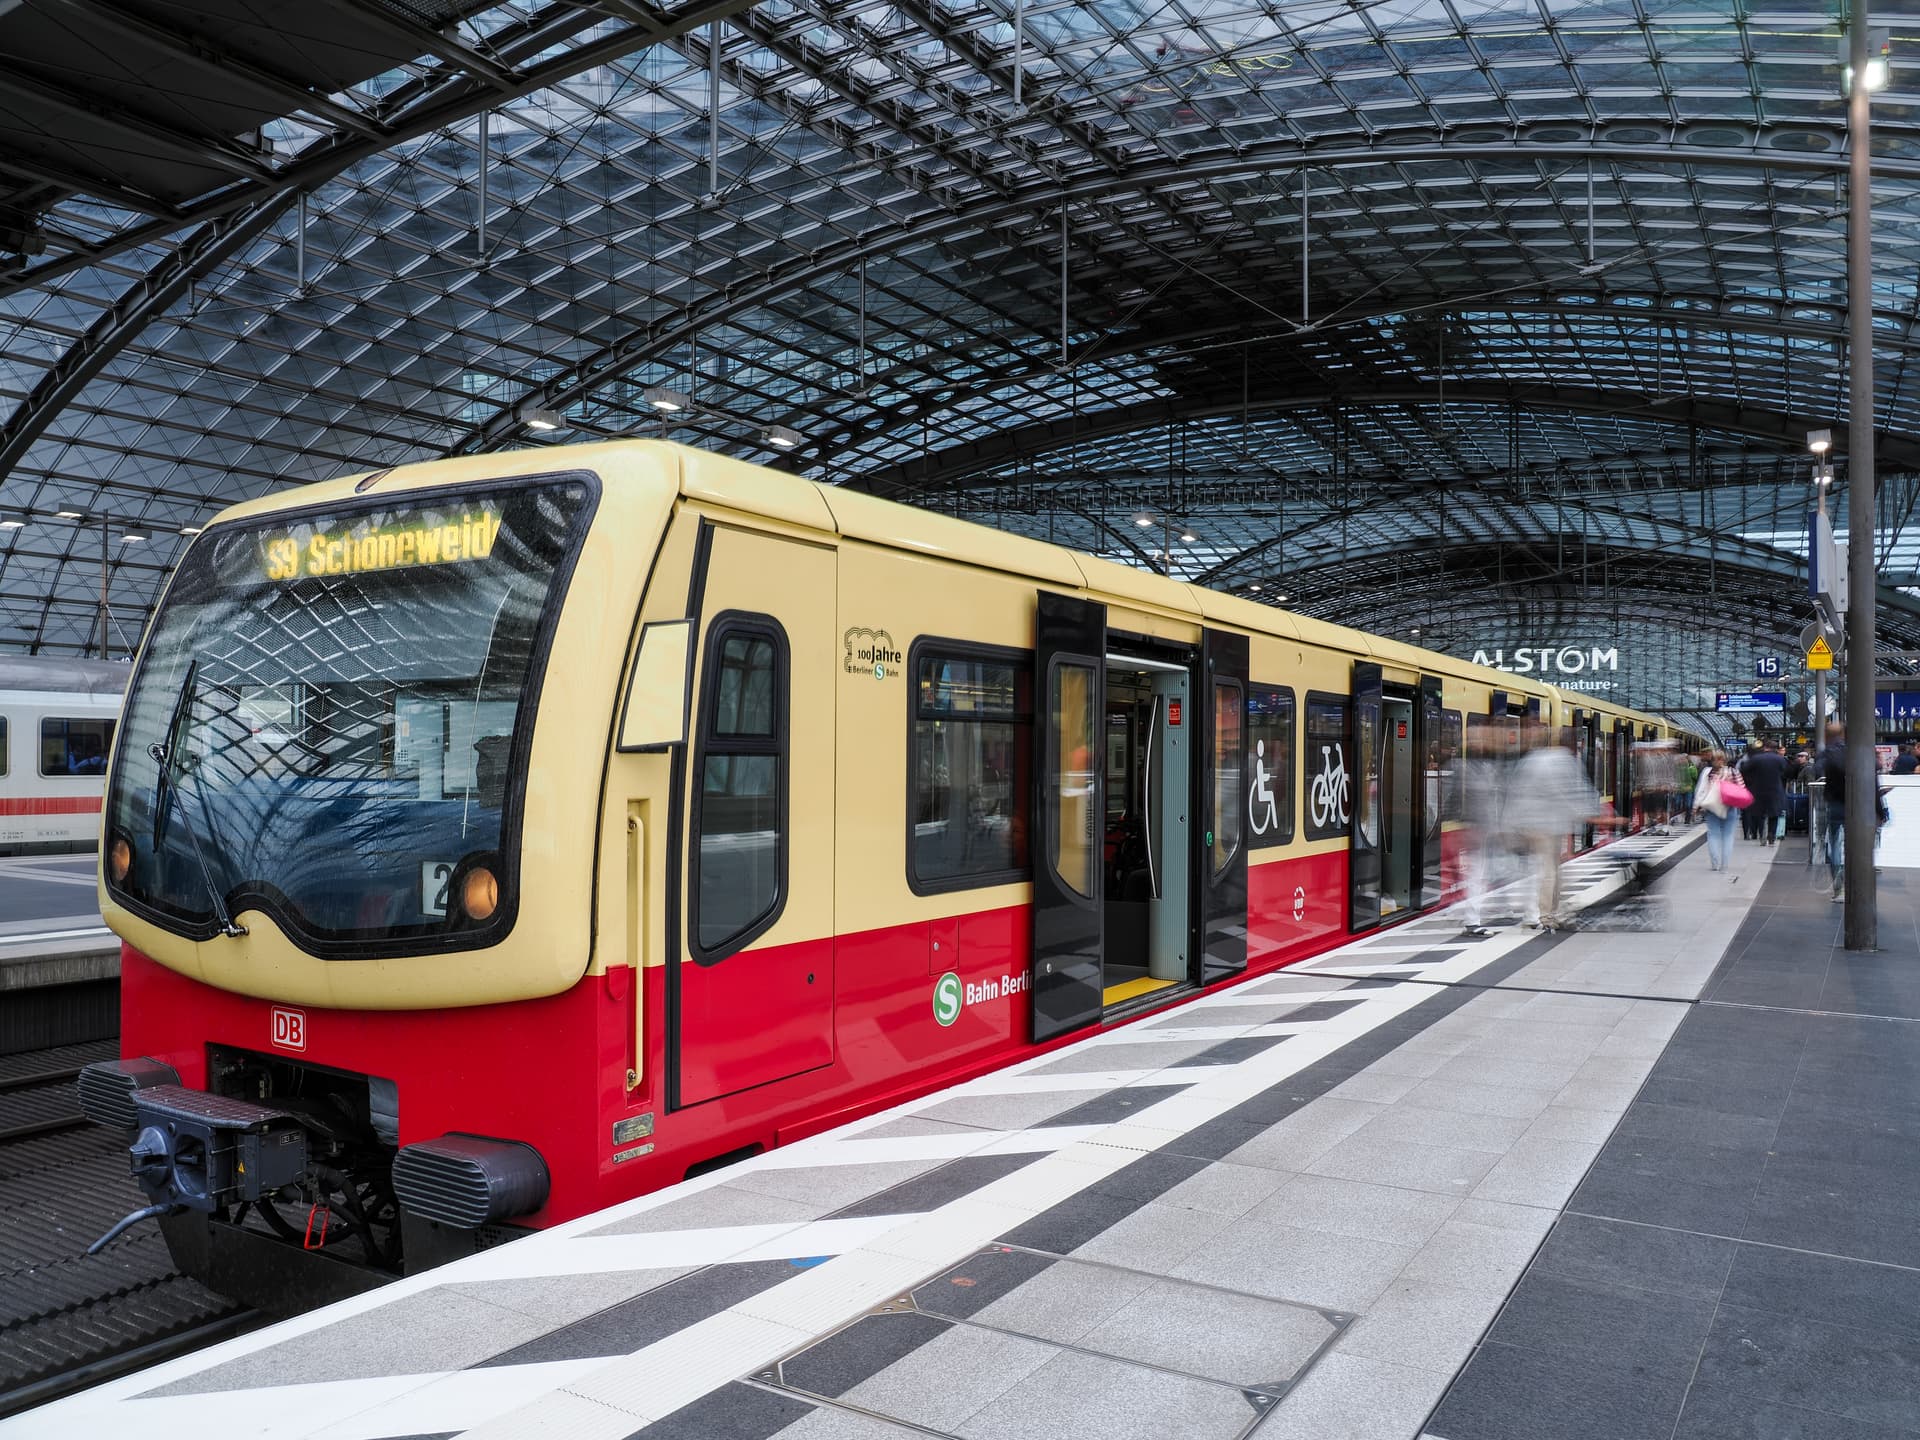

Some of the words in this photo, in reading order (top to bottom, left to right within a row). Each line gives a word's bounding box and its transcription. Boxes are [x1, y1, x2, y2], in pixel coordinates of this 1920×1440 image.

[268, 538, 298, 580] S9
[1472, 646, 1618, 673] ALSTOM
[1757, 658, 1777, 673] 15
[433, 864, 453, 910] 2
[938, 979, 958, 1020] S
[966, 979, 998, 1006] Bahn
[275, 1012, 302, 1044] DB
